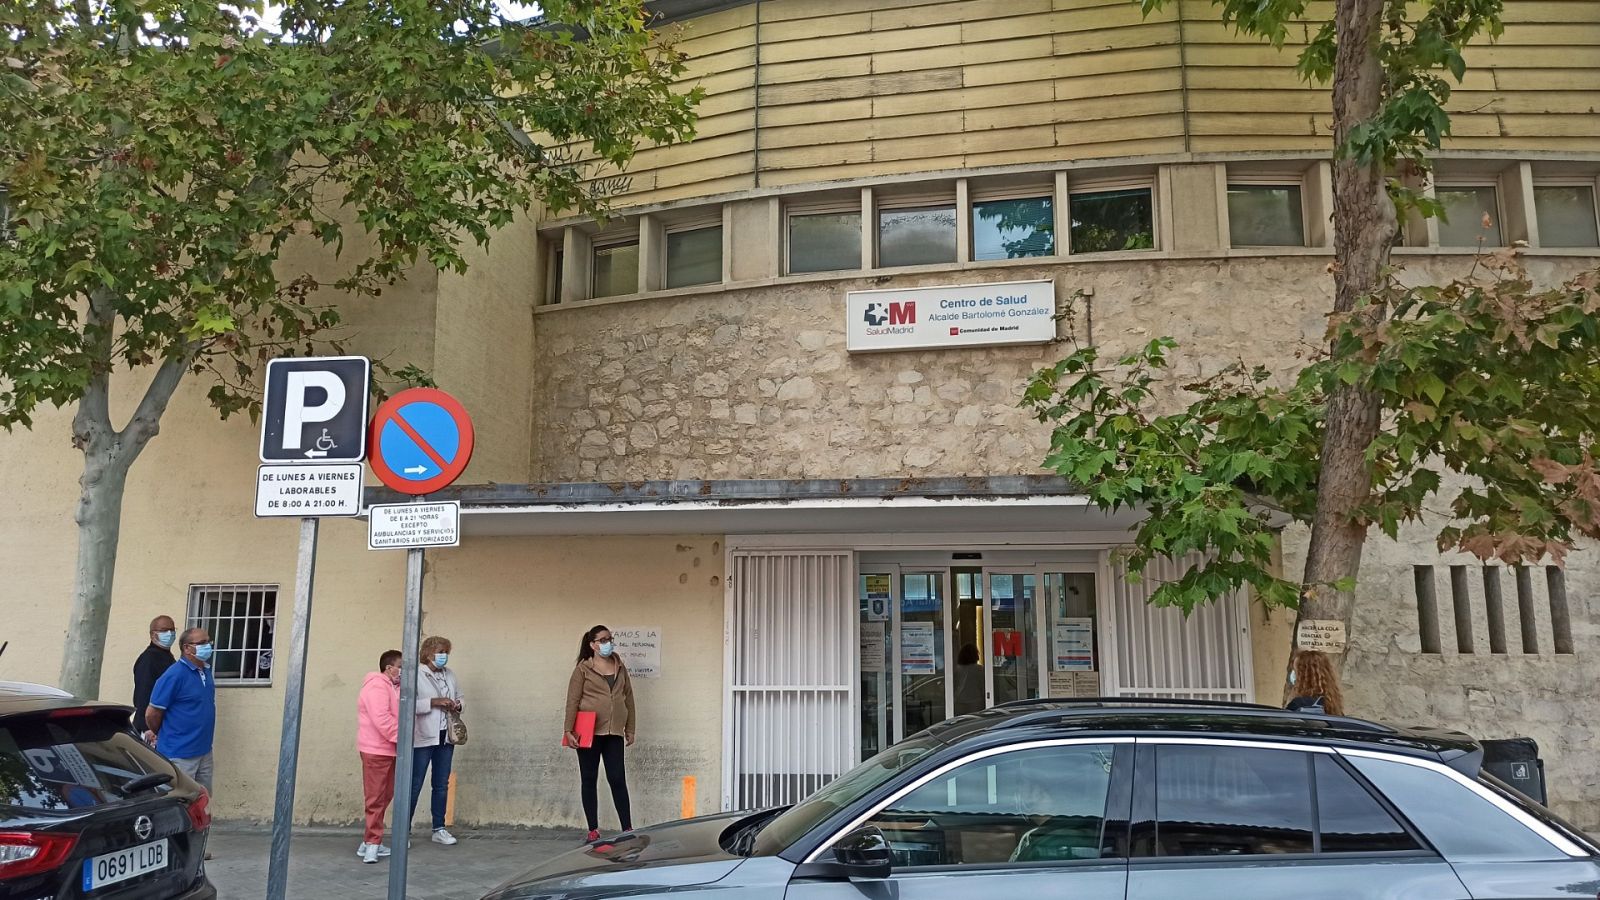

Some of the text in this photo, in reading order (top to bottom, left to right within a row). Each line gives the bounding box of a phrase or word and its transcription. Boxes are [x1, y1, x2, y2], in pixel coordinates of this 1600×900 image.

[940, 294, 1028, 309] Centro de Salud
[929, 307, 1049, 322] Alcalde Bartolomé González
[282, 370, 346, 449] P
[276, 473, 306, 481] LUNES
[318, 472, 355, 480] VIERNES
[279, 486, 337, 494] LABORABLES
[268, 500, 279, 508] DE
[282, 500, 302, 508] 8:00
[338, 499, 348, 507] H.
[374, 529, 416, 537] AMBULANCIAS
[375, 535, 453, 545] SANITARIOS AUTORIZADOS
[98, 844, 163, 880] 0691 LDB
